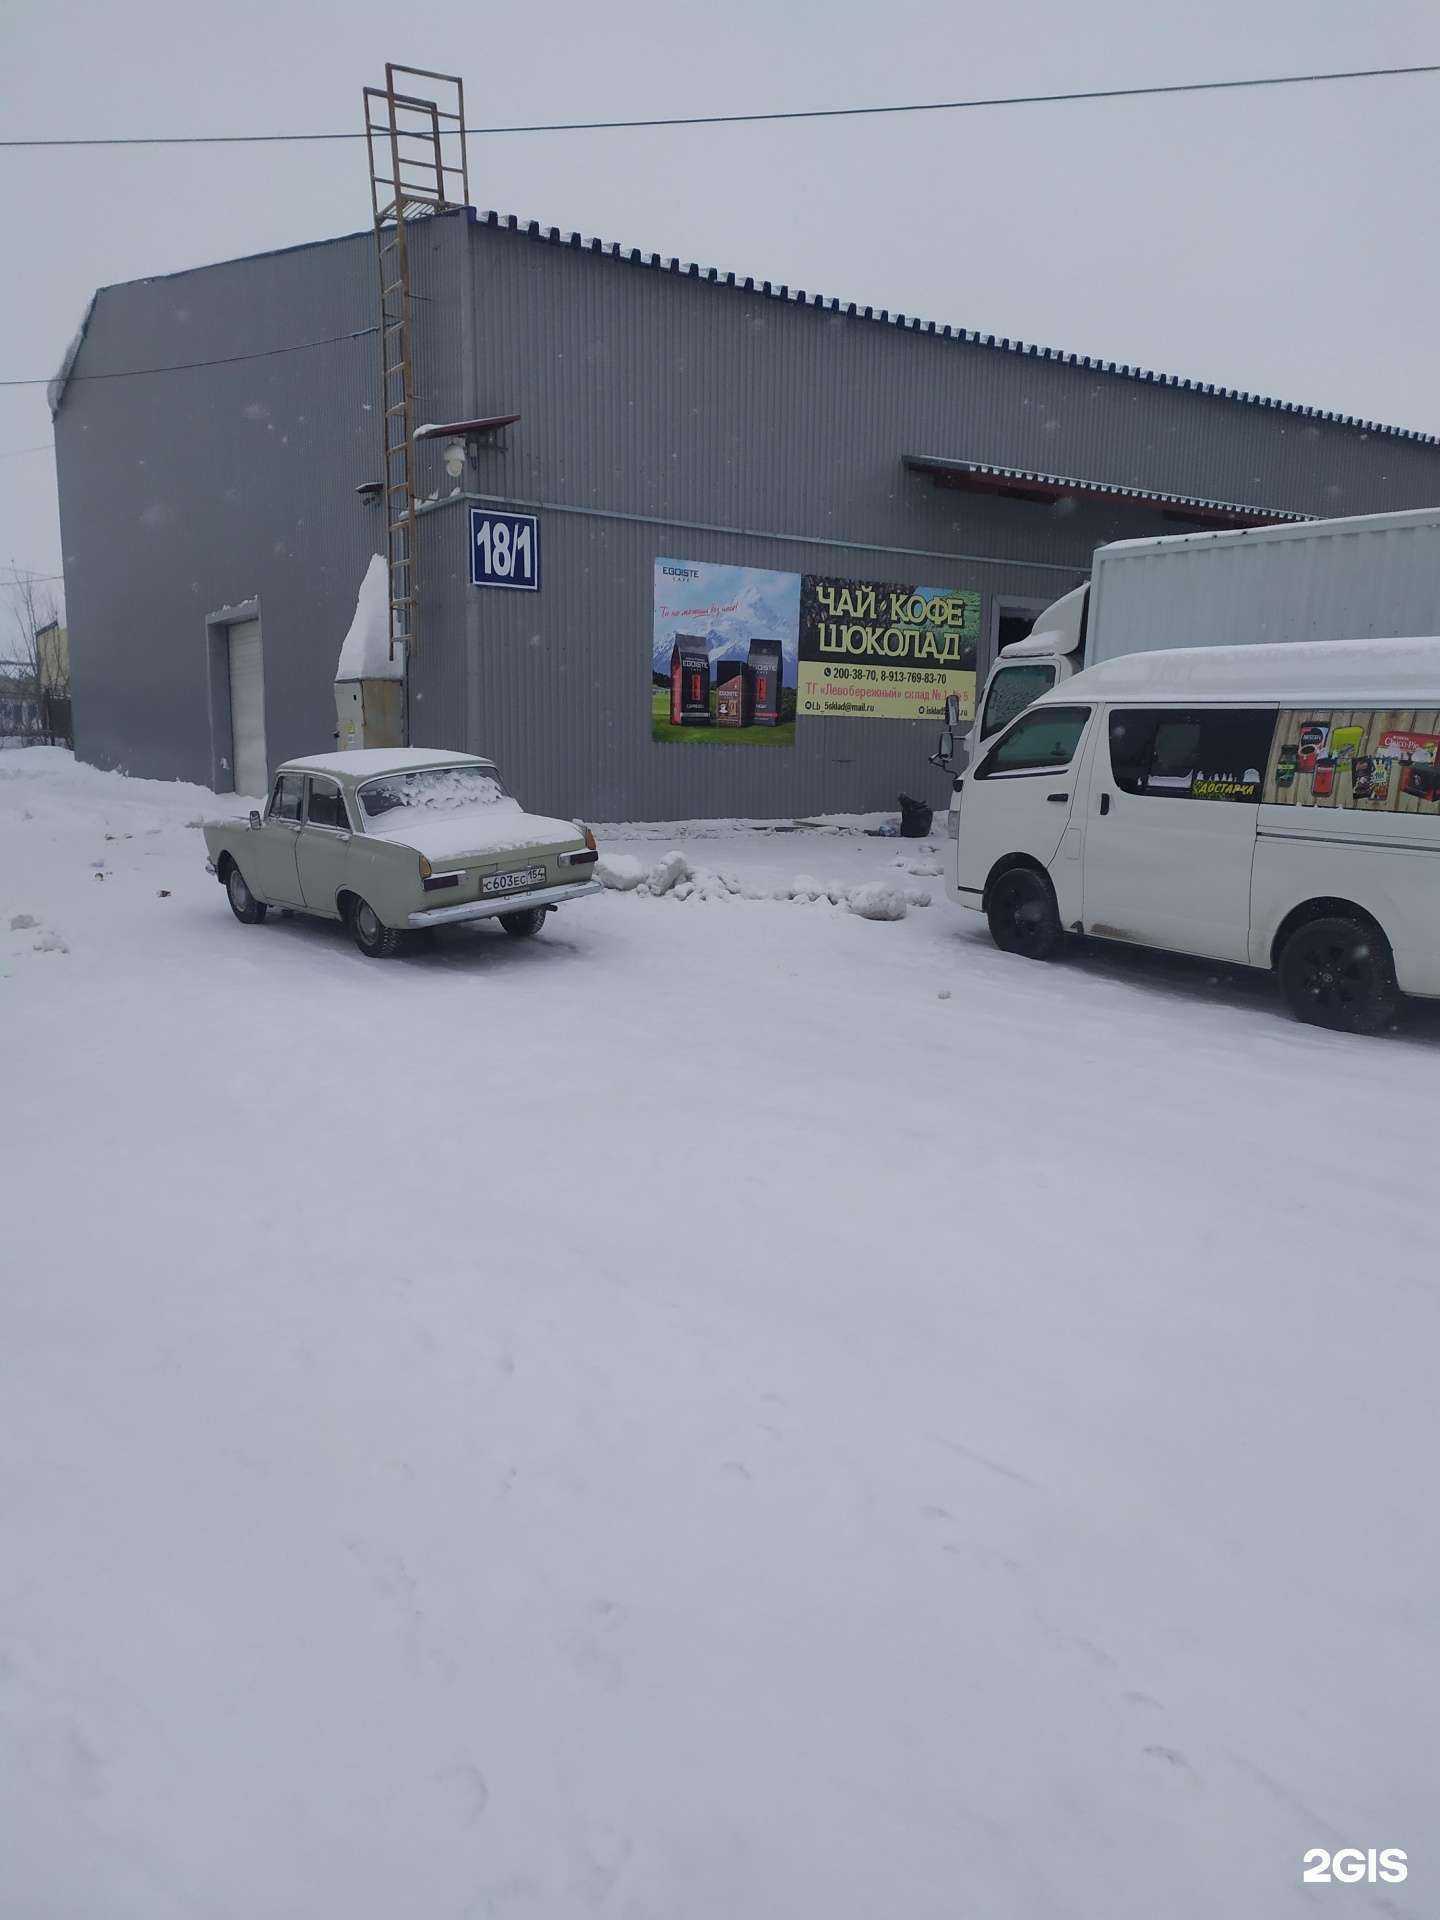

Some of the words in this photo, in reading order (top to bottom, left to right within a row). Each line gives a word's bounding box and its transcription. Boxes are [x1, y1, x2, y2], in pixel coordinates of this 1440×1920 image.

[477, 520, 531, 578] 18/1
[816, 584, 877, 619] ЧАЙ
[889, 593, 964, 626] КОФЕ
[818, 622, 961, 665] ШОКОЛАД
[833, 667, 879, 683] 200-38-70,
[880, 669, 947, 685] 8-913-769-83-70
